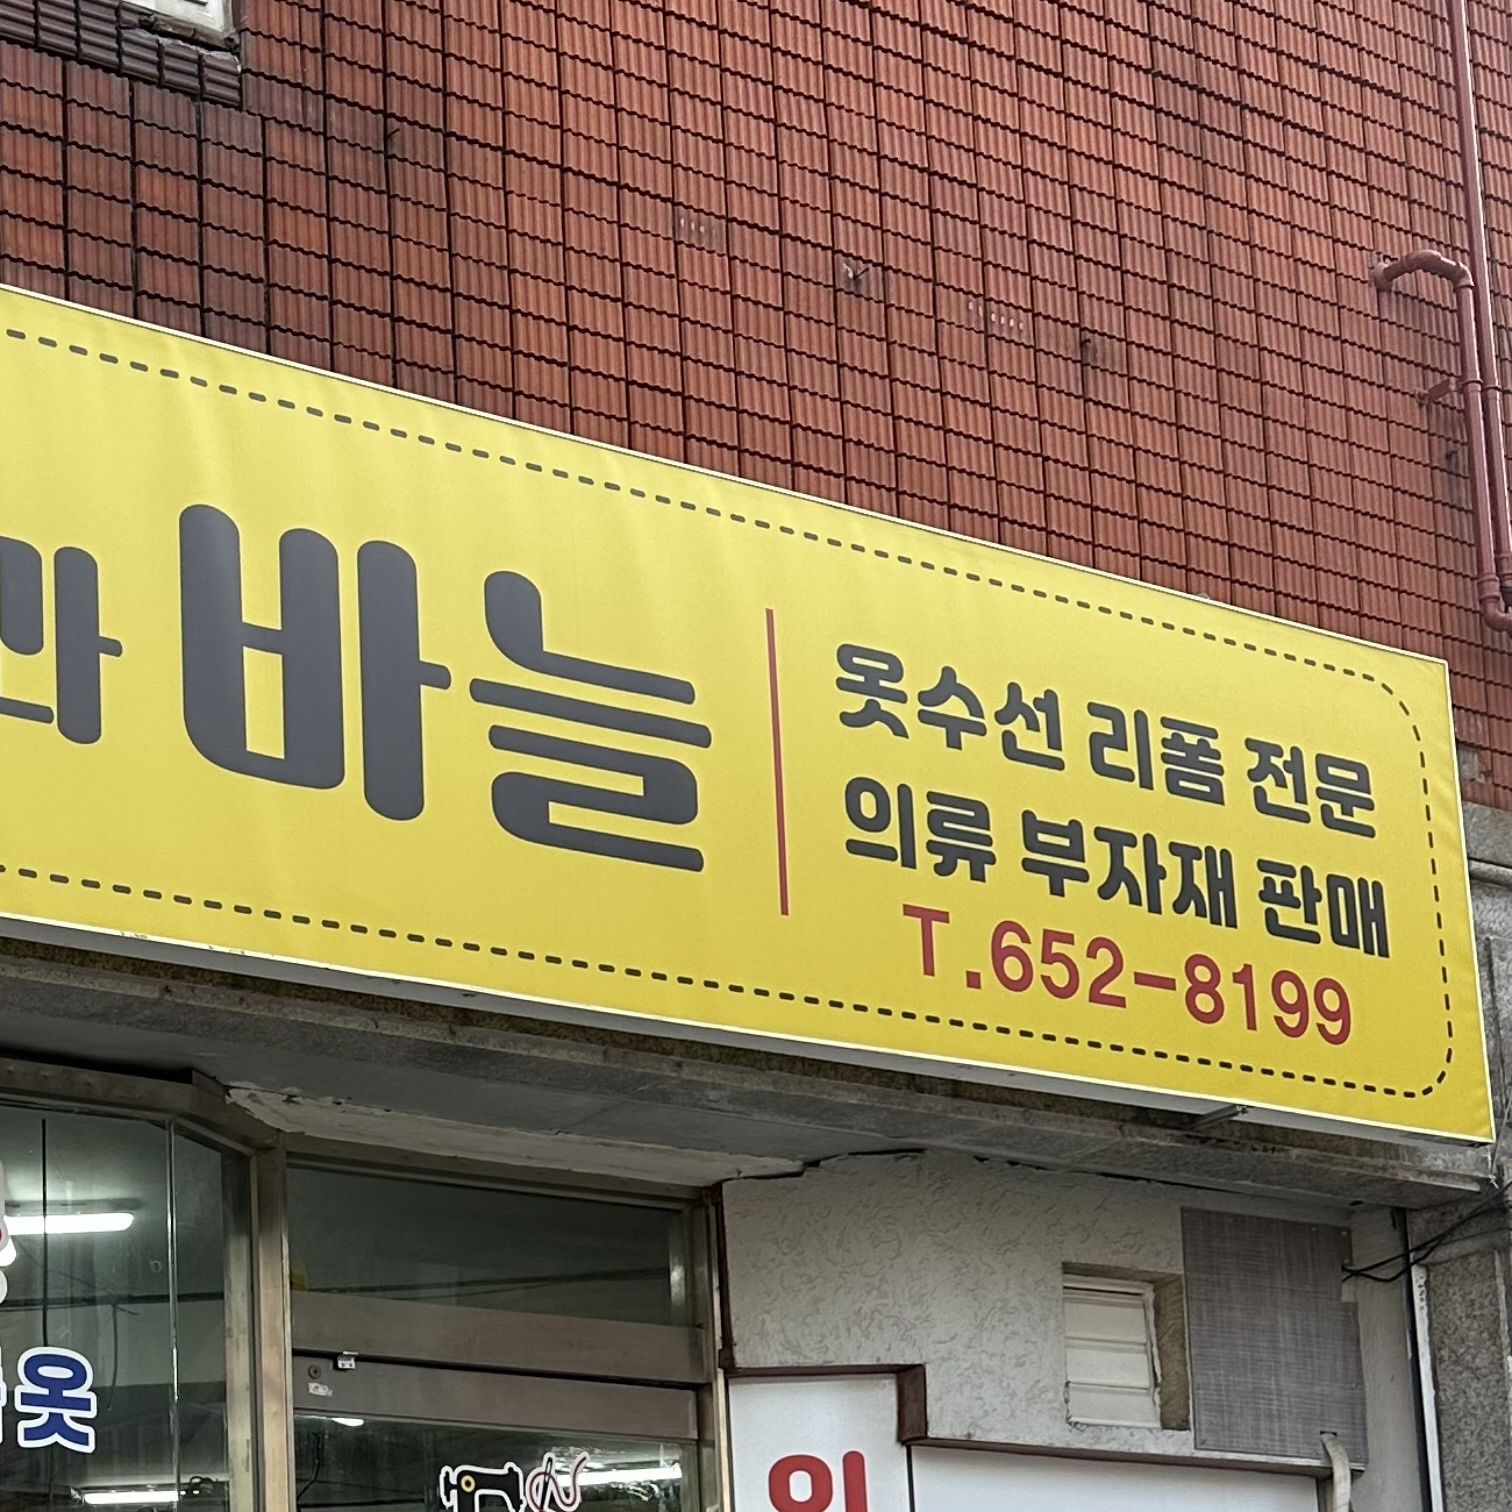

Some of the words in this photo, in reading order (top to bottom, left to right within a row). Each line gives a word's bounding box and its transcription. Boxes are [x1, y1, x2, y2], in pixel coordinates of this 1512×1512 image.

[836, 642, 1064, 770] 옷수선
[1087, 701, 1225, 806] 리폼
[1245, 737, 1376, 839] 전문
[845, 777, 995, 883] 의류
[1021, 810, 1239, 930] 부자재
[1257, 858, 1390, 958] 판매
